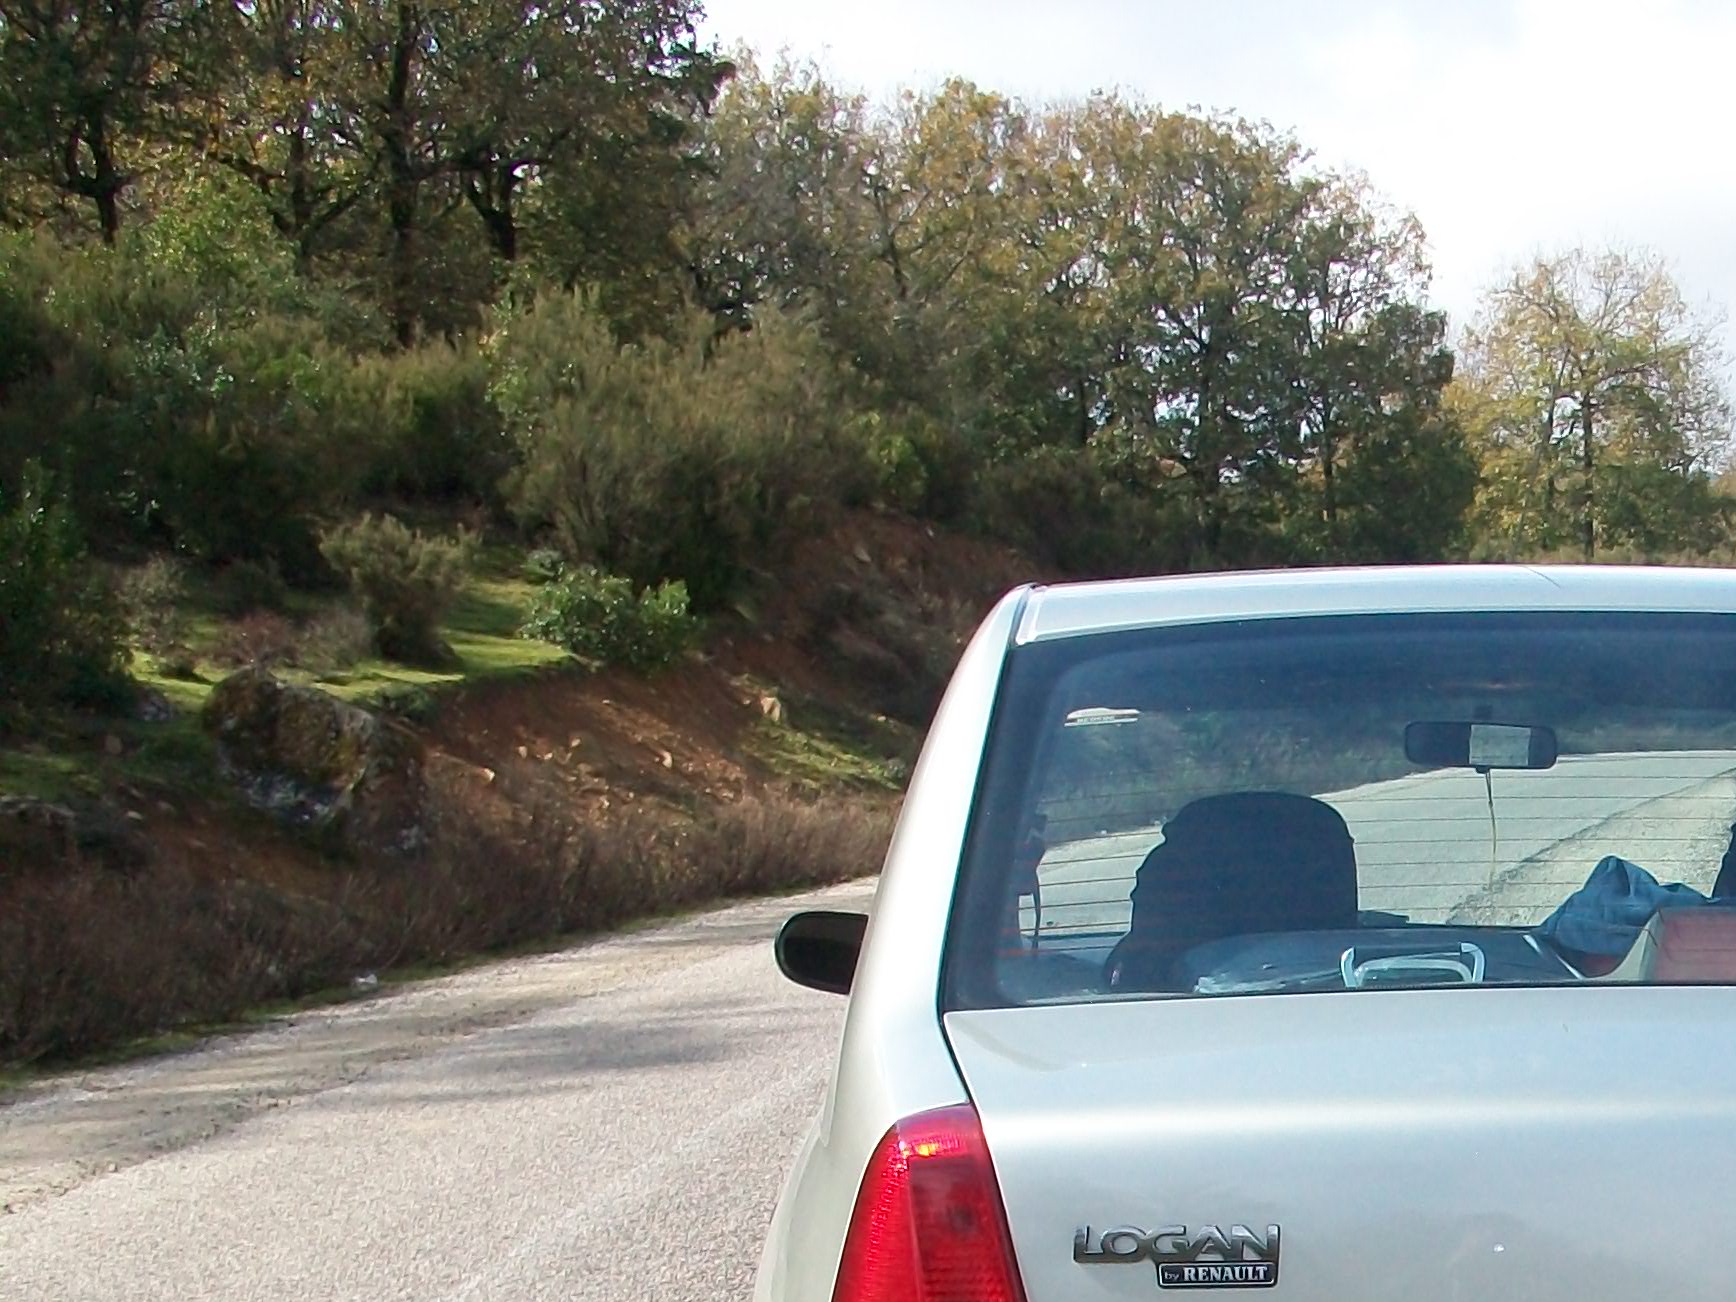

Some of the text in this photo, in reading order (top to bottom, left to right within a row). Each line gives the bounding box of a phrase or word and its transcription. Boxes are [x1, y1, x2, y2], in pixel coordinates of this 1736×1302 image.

[1073, 1224, 1281, 1263] LOGAN
[1164, 1266, 1268, 1282] by RENAULT
